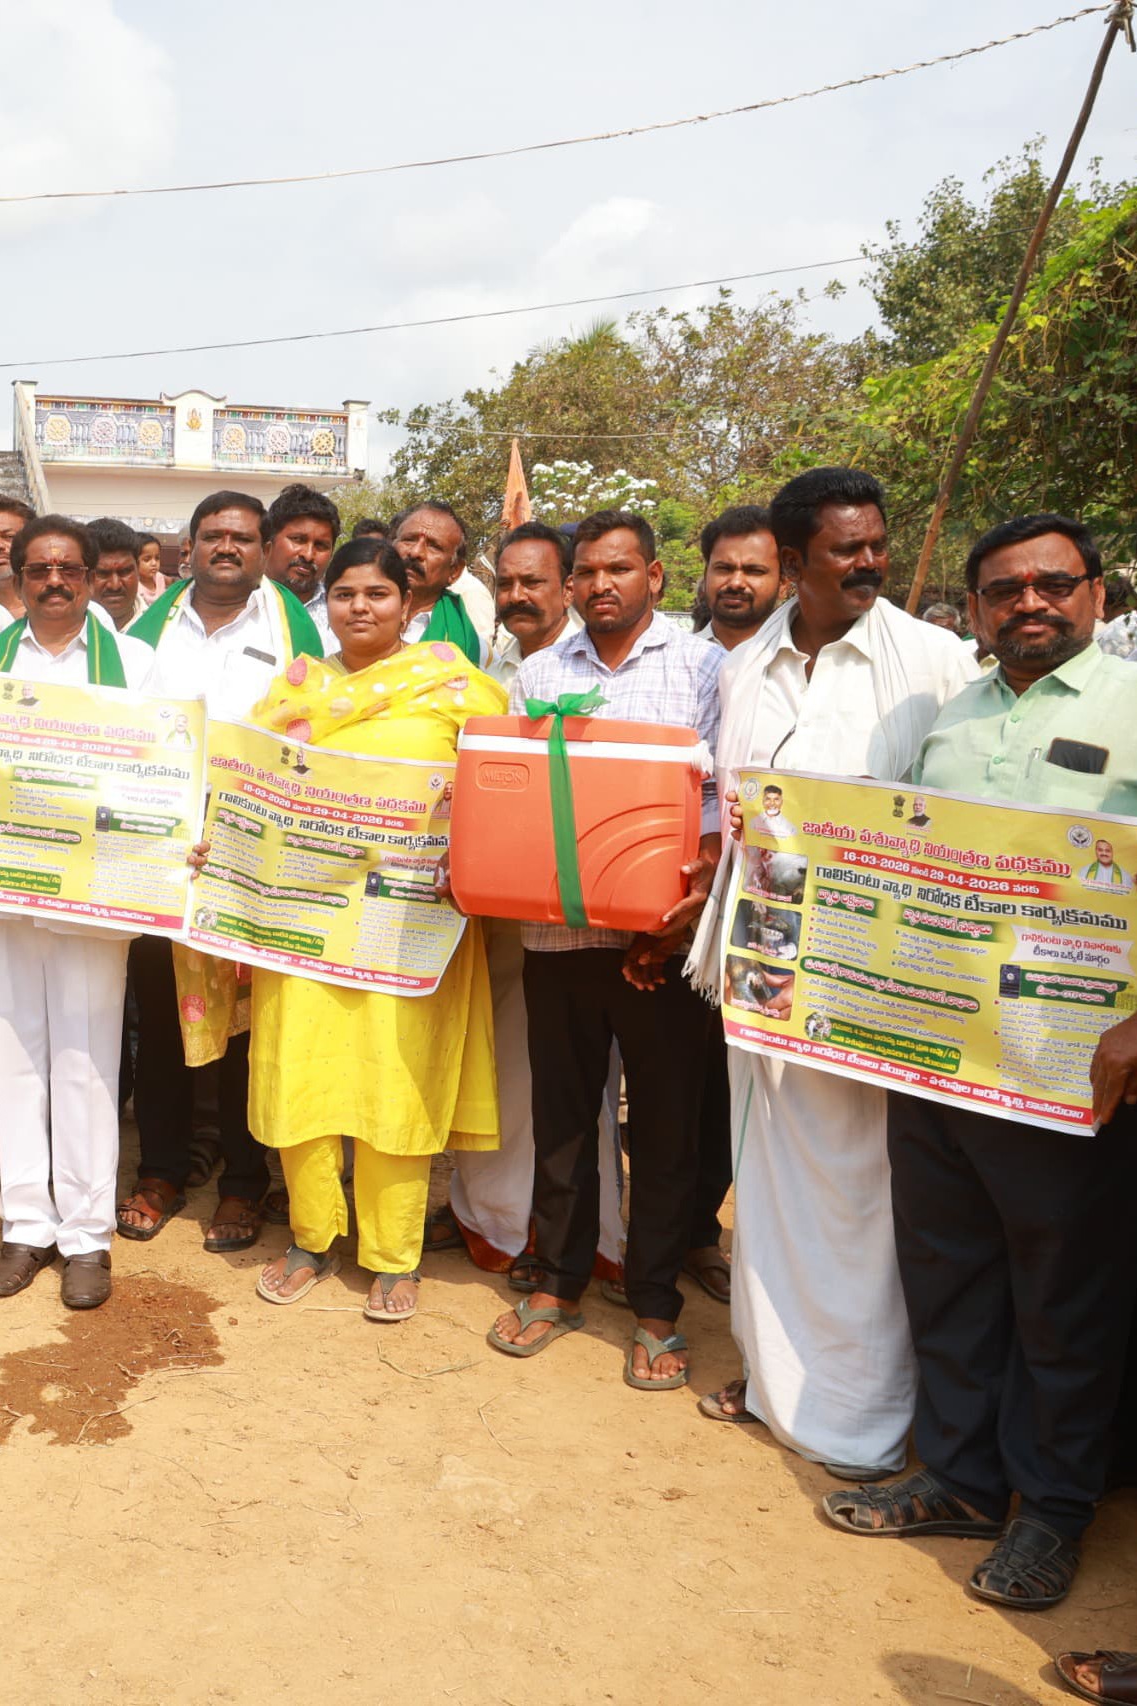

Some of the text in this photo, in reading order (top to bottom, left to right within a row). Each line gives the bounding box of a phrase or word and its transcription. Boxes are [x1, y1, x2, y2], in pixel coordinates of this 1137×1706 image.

[28, 751, 73, 765] నిరోధక
[116, 762, 190, 780] కార్యక్రమము
[210, 756, 254, 777] జాతీయ
[257, 768, 301, 796] పశువ్యాధి
[304, 786, 371, 807] నియంత్రణ
[219, 791, 267, 816] గాలికుంటు
[268, 811, 294, 828] వ్యాధి
[299, 819, 344, 837] నిరోధక
[347, 826, 385, 843] టీకాల
[313, 807, 383, 825] 29-04-2026
[802, 822, 1072, 878] జాతీయ పశువ్యాధి నియంత్రణ పథకము
[843, 851, 910, 872] 16-03-2026
[929, 870, 1010, 891] 29-04-2026
[1012, 883, 1040, 894] వరకు
[816, 866, 1128, 930] గాలికుంటు వ్యాధి నిరోధక టీకాల కార్యక్రమము
[817, 889, 840, 905] వ్యాధి
[1022, 934, 1122, 954] గాలికుంటు వ్యాధి నివారణకు
[1033, 945, 1110, 968] టీకాలు ఒక్కటే మార్గం
[739, 1028, 788, 1047] గాలికుంటు
[789, 1040, 810, 1055] వ్యాధి
[812, 1045, 845, 1062] నిరోధక
[847, 1053, 879, 1070] టీకాలు
[880, 1061, 920, 1083] వేయిద్దాం
